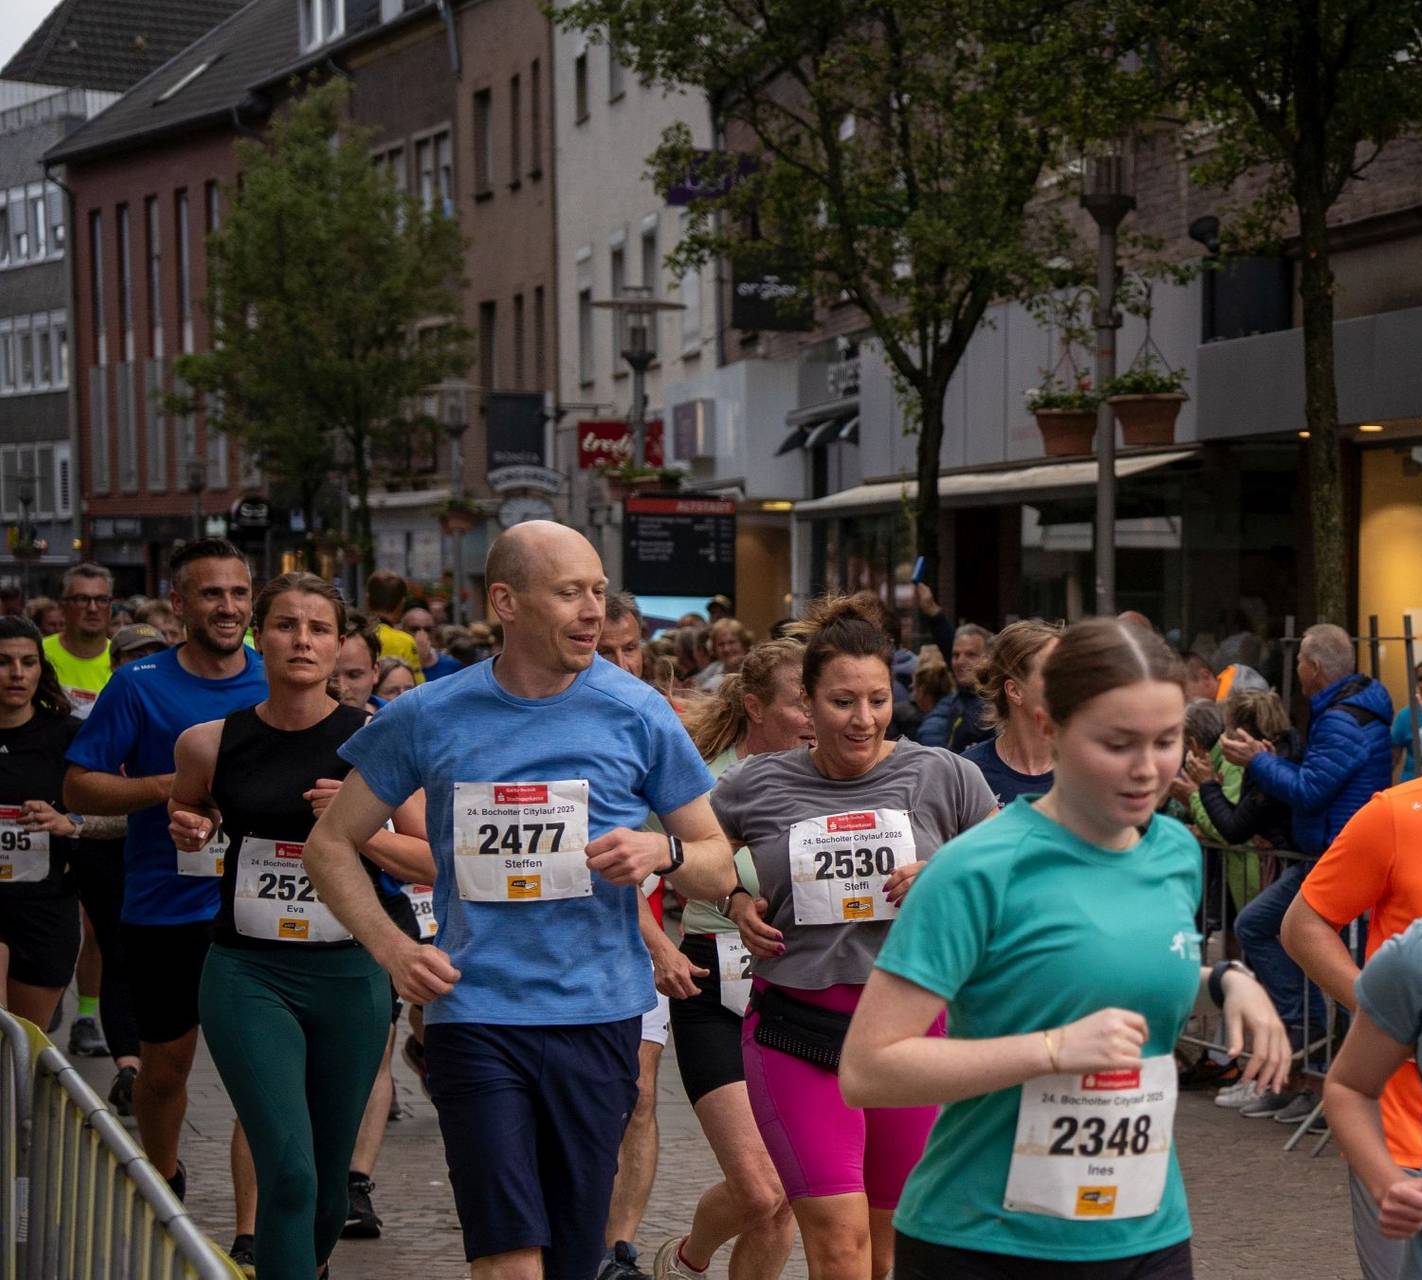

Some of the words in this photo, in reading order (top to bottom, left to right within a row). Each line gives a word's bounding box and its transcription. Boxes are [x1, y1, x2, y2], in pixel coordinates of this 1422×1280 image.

[467, 808, 479, 816] 24.
[481, 808, 521, 816] Bocholter
[523, 807, 555, 816] Citylauf
[556, 805, 575, 814] 2025
[479, 822, 565, 855] 2477
[815, 836, 852, 845] Bocholter
[853, 832, 883, 842] Citylauf
[884, 831, 903, 839] 2025
[263, 860, 299, 868] Bocholter
[505, 859, 543, 868] Steffen
[814, 846, 895, 880] 2530
[258, 873, 319, 902] 252
[844, 881, 870, 891] Steffi
[286, 904, 304, 913] Eva
[1060, 1095, 1112, 1106] Bocholter
[1048, 1114, 1151, 1157] 2348
[1087, 1164, 1115, 1176] Ines
